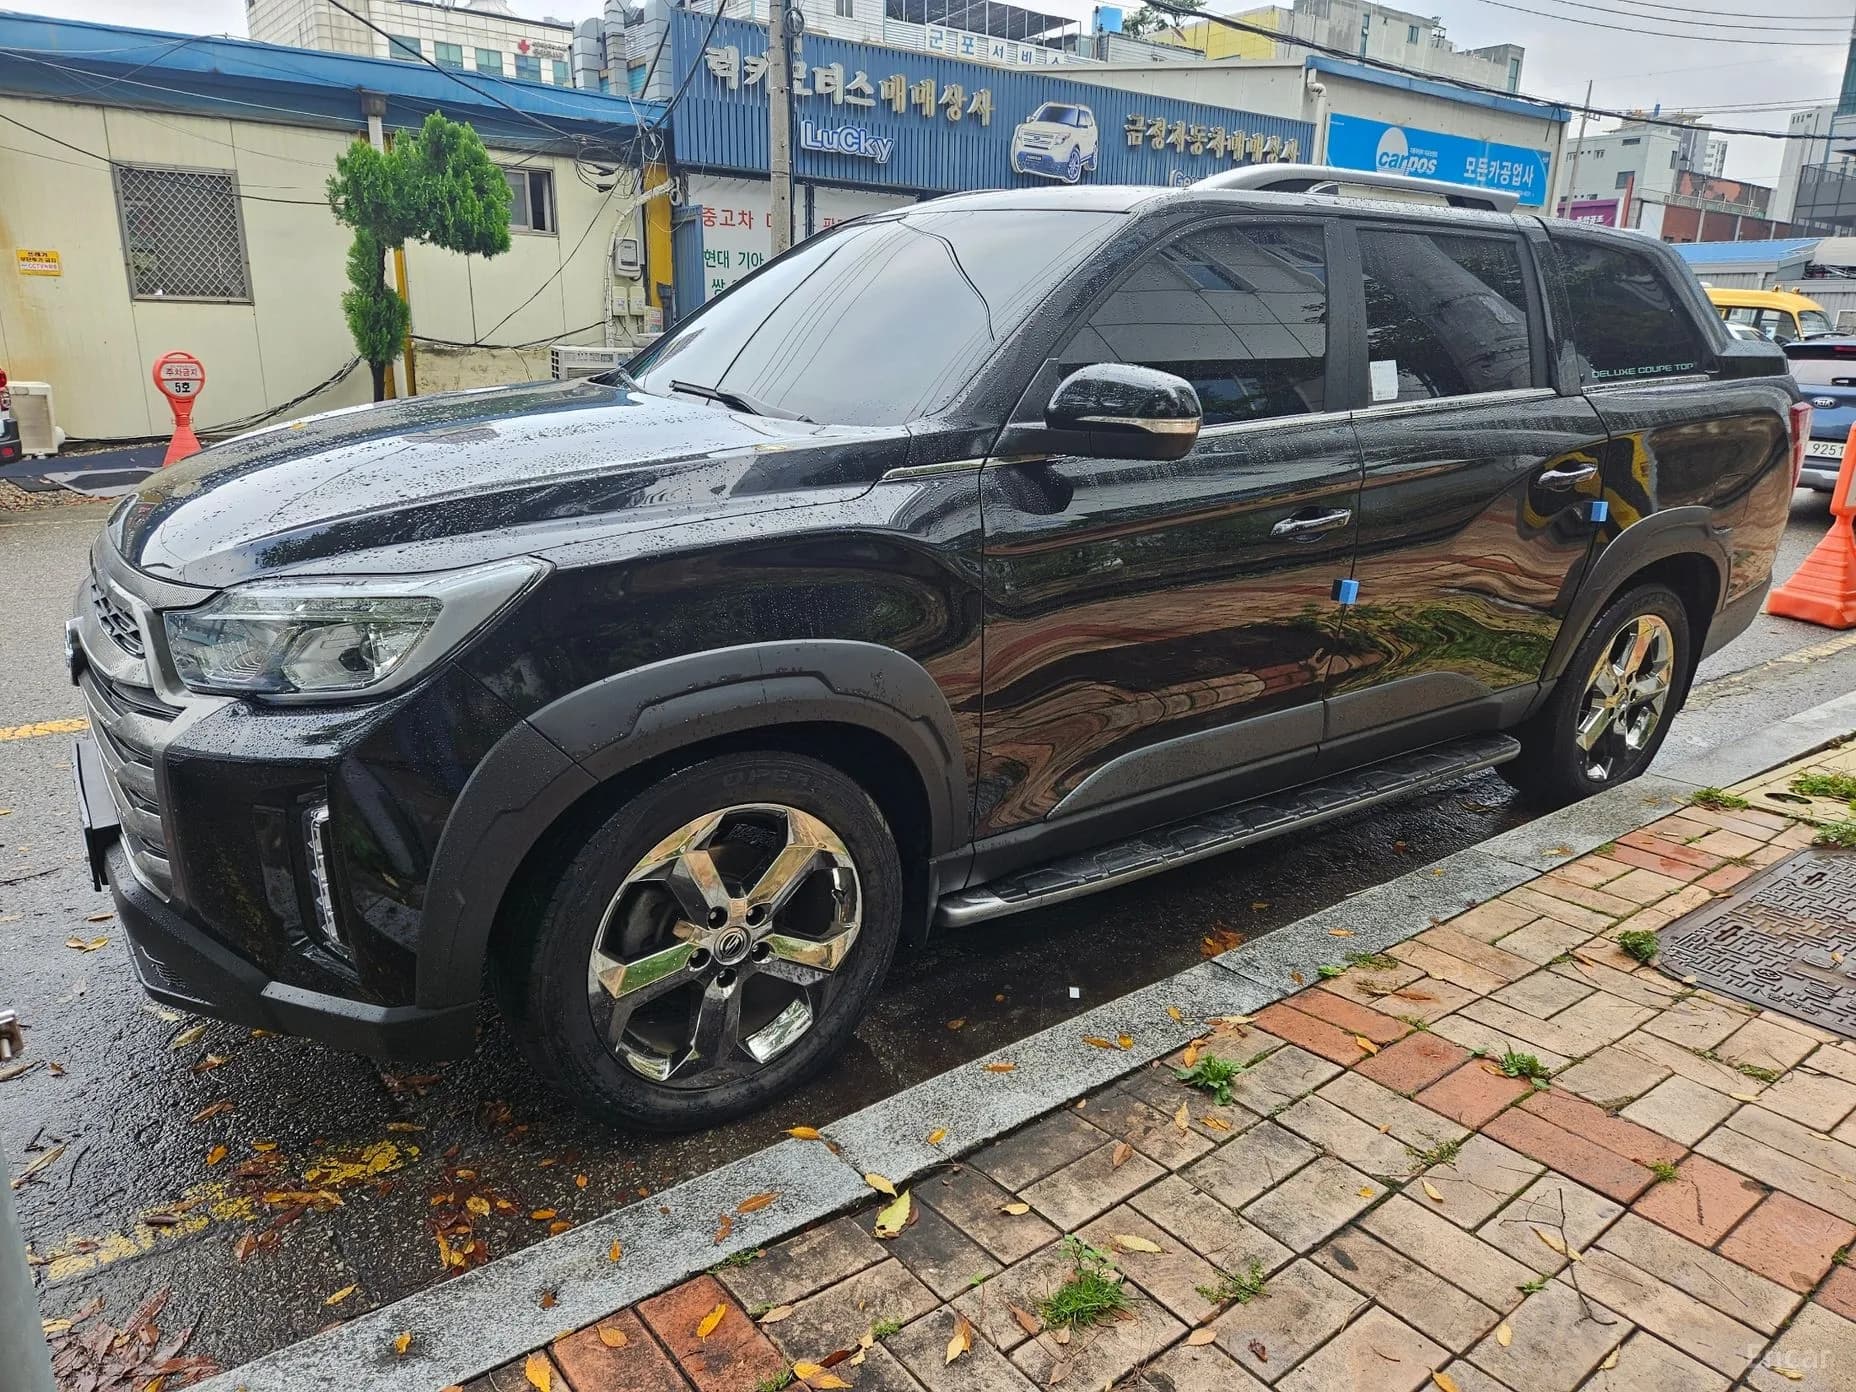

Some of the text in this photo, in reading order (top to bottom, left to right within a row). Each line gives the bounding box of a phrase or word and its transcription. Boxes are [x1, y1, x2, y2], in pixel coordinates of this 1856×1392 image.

[1378, 151, 1438, 175] carpos
[702, 207, 754, 229] 중고차
[704, 249, 764, 270] 현대 기아
[166, 368, 198, 377] 주차금지
[1591, 362, 1694, 378] DELUXE COUPE TOP
[174, 381, 191, 393] 5호
[1812, 443, 1844, 456] 9251
